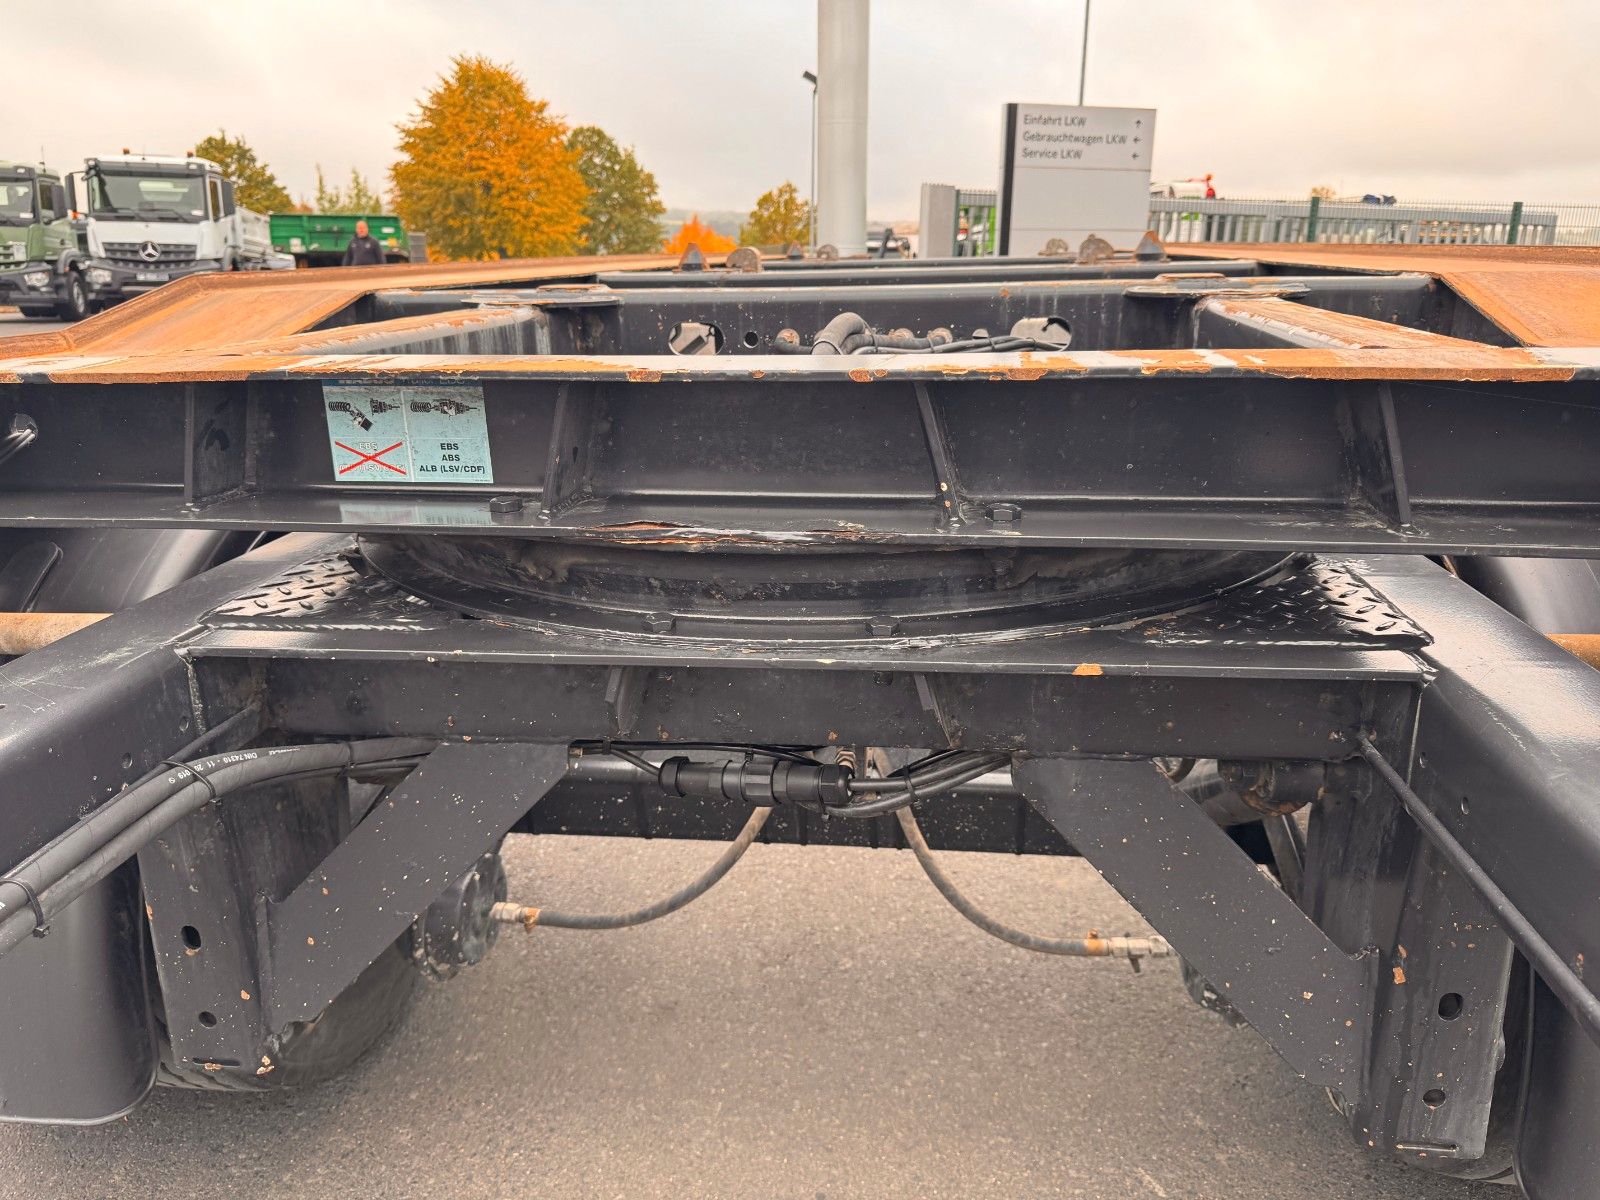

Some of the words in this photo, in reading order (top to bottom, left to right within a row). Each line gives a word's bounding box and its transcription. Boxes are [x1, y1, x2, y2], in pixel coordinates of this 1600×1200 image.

[1023, 115, 1062, 126] Einfahrt
[1064, 116, 1087, 127] LKW
[1022, 131, 1103, 146] Gebrauchtwagen
[1105, 134, 1127, 144] LKW
[1022, 148, 1058, 158] Service
[1061, 149, 1083, 159] LKW
[440, 442, 459, 451] EBS
[442, 453, 460, 462] ABS
[419, 464, 438, 473] ALB
[440, 464, 485, 474] (LSV/CDF)
[243, 752, 258, 760] DIN
